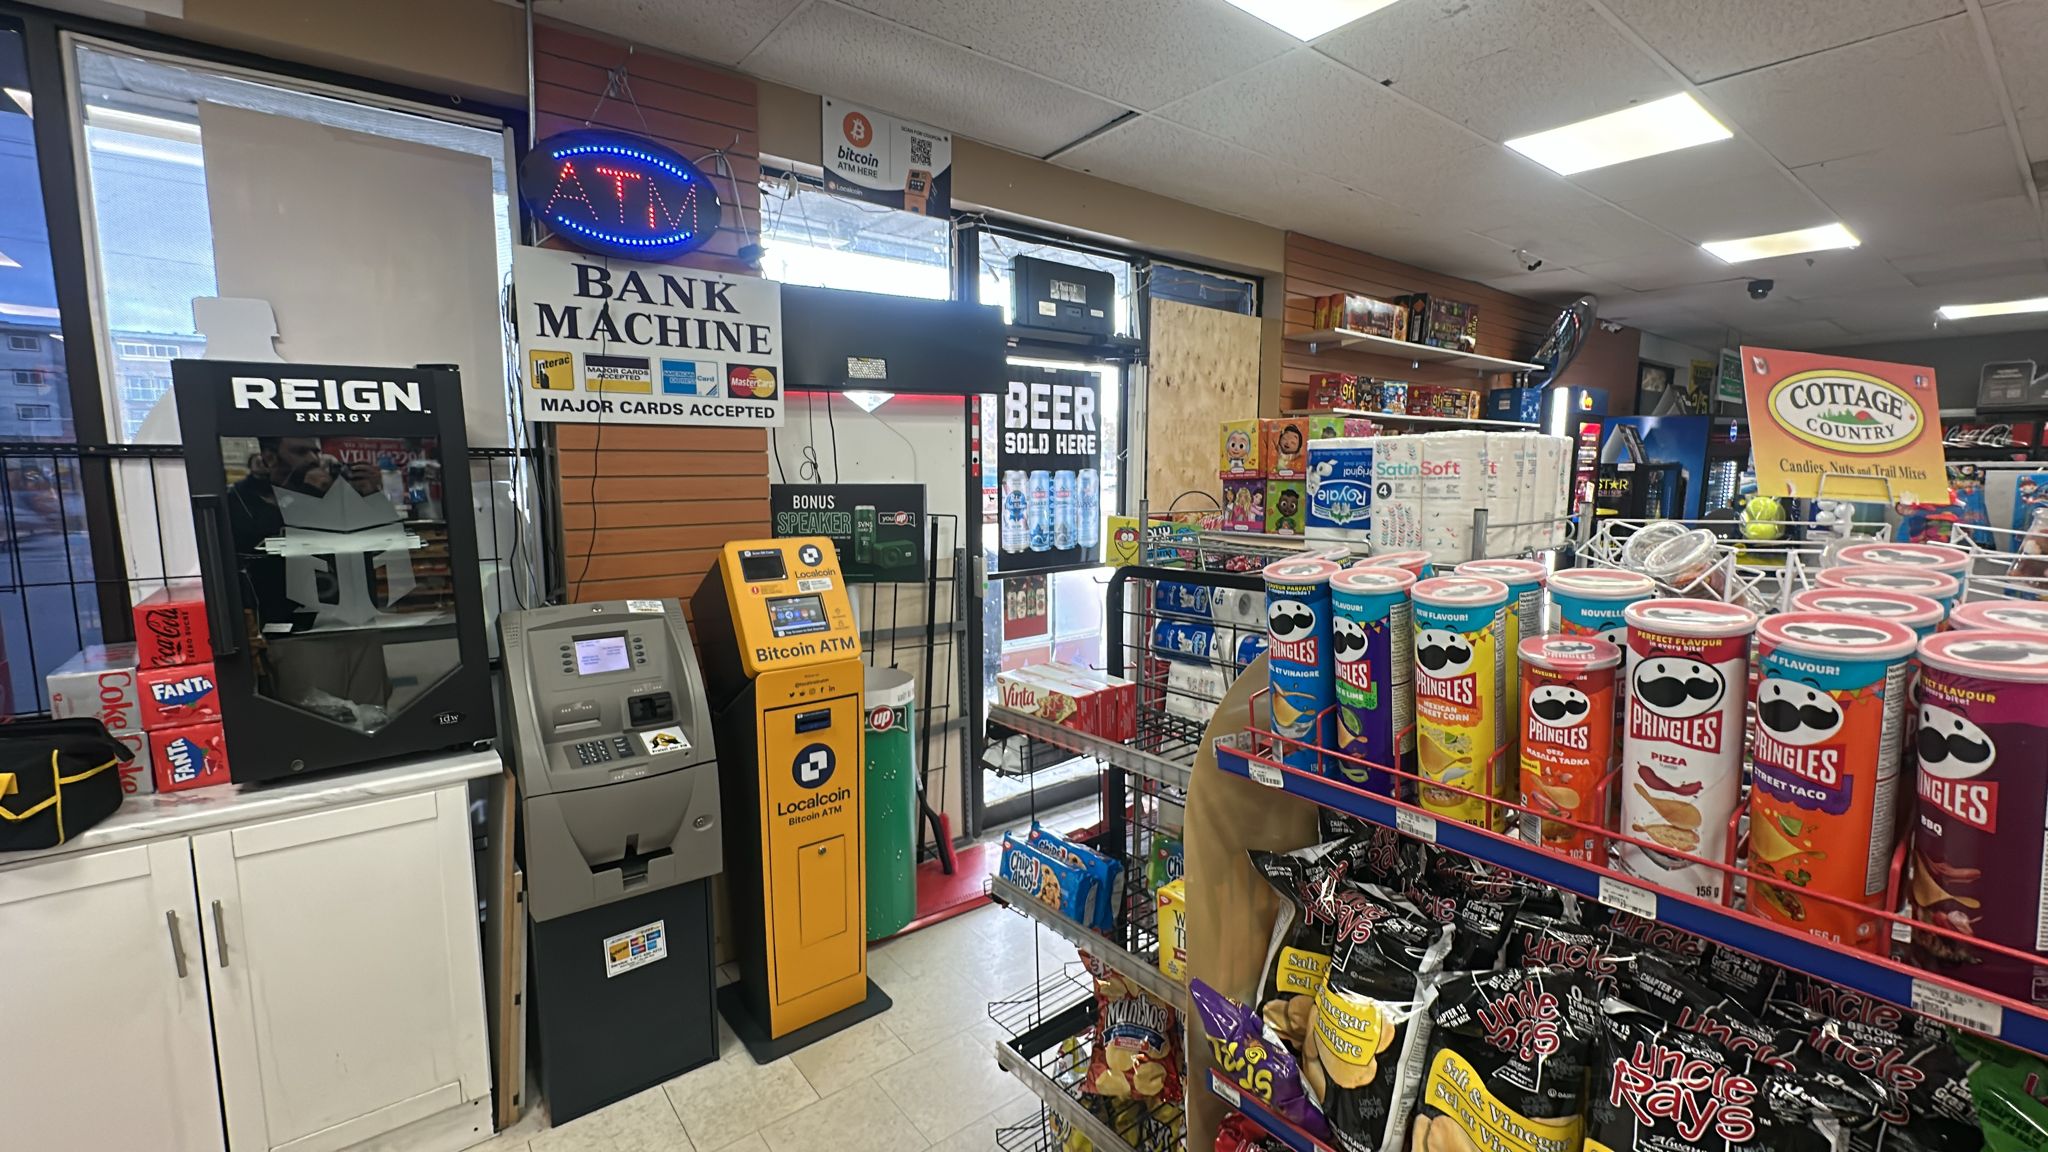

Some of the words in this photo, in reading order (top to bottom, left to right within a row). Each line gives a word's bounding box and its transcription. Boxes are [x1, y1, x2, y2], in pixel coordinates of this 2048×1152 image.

[838, 145, 879, 168] bitcoin
[838, 161, 856, 173] ATM
[857, 165, 878, 179] HERE
[545, 162, 698, 233] ATM
[571, 262, 741, 314] BANK
[534, 302, 773, 355] MACHINE
[534, 356, 570, 372] Interac
[587, 366, 613, 374] MAJOR
[597, 373, 641, 381] ACCEPTED
[731, 376, 775, 388] MasterCard
[231, 377, 422, 411] REIGN
[1789, 382, 1903, 420] COTTAGE
[541, 398, 613, 413] MAJOR
[620, 401, 684, 415] CARDS
[690, 403, 775, 419] ACCEPTED
[1004, 381, 1096, 431] BEER
[296, 413, 372, 422] ENERGY
[1806, 418, 1895, 440] COUNTRY
[1004, 432, 1049, 455] SOLD
[1056, 433, 1096, 455] HERE
[1829, 460, 1855, 474] Nuts
[1857, 466, 1871, 475] and
[1872, 464, 1897, 478] Trail
[1898, 465, 1927, 480] Mixes
[793, 495, 835, 509] BONUS
[1317, 485, 1366, 506] Royale
[777, 512, 851, 534] SPEAKER
[896, 514, 907, 523] up
[795, 569, 836, 579] Localcoin
[1429, 612, 1469, 622] FLAVOUR!
[756, 642, 815, 662] Bitcoin
[820, 636, 855, 654] ATM
[1268, 633, 1315, 664] PRINGLES
[1637, 631, 1673, 646] PERFECT
[1675, 637, 1722, 648] FLAVOUR
[1657, 642, 1681, 652] every
[1683, 643, 1704, 653] bite!
[1283, 667, 1320, 677] VINAIGRE
[1778, 657, 1840, 675] FLAVOUR!
[151, 677, 213, 700] FANTA
[1002, 684, 1035, 707] Vinta
[1416, 670, 1473, 704] PRINGLES
[1938, 684, 1996, 704] FLAVOUR
[98, 672, 133, 730] Coke
[1423, 700, 1457, 713] MEXICAN
[873, 710, 890, 726] up
[896, 712, 902, 723] ?
[1418, 705, 1443, 720] STREET
[1444, 712, 1469, 722] CORN
[1529, 716, 1588, 749] PRINGLES
[1632, 703, 1718, 749] PRINGLES
[167, 737, 196, 784] FANTA
[1526, 747, 1557, 763] MASALA
[1559, 757, 1590, 765] TADKA
[1651, 751, 1687, 767] PIZZA
[1754, 728, 1839, 785] PRINGLES
[1754, 768, 1787, 792] STREET
[1789, 783, 1827, 801] TACO
[777, 787, 851, 817] Localcoin
[788, 811, 820, 826] Bitcoin
[822, 805, 842, 817] ATM
[1921, 815, 1943, 836] BBQ
[1010, 851, 1034, 873] Chips
[1570, 847, 1583, 860] 102
[1696, 884, 1711, 897] 156
[1462, 908, 1478, 921] Gras
[1466, 900, 1487, 913] Trans
[1489, 907, 1504, 921] Fat
[1288, 952, 1319, 971] Salt
[1523, 933, 1618, 974] uncle
[1712, 955, 1731, 969] Gras
[1732, 964, 1758, 985] Trans
[1743, 955, 1762, 975] Fat
[1287, 972, 1310, 989] Sel
[1640, 972, 1672, 994] CHAPTER
[1673, 990, 1683, 999] 15
[1458, 1004, 1467, 1014] 15
[1569, 1005, 1588, 1022] Gras
[1796, 981, 1902, 1030] uncle
[1631, 1041, 1757, 1105] uncle
[1434, 1081, 1458, 1109] Sel
[1461, 1109, 1476, 1131] et
[1443, 1058, 1470, 1093] Salt
[1469, 1087, 1484, 1111] &
[1488, 1100, 1573, 1152] Vinegar
[1610, 1058, 1755, 1142] Rays
